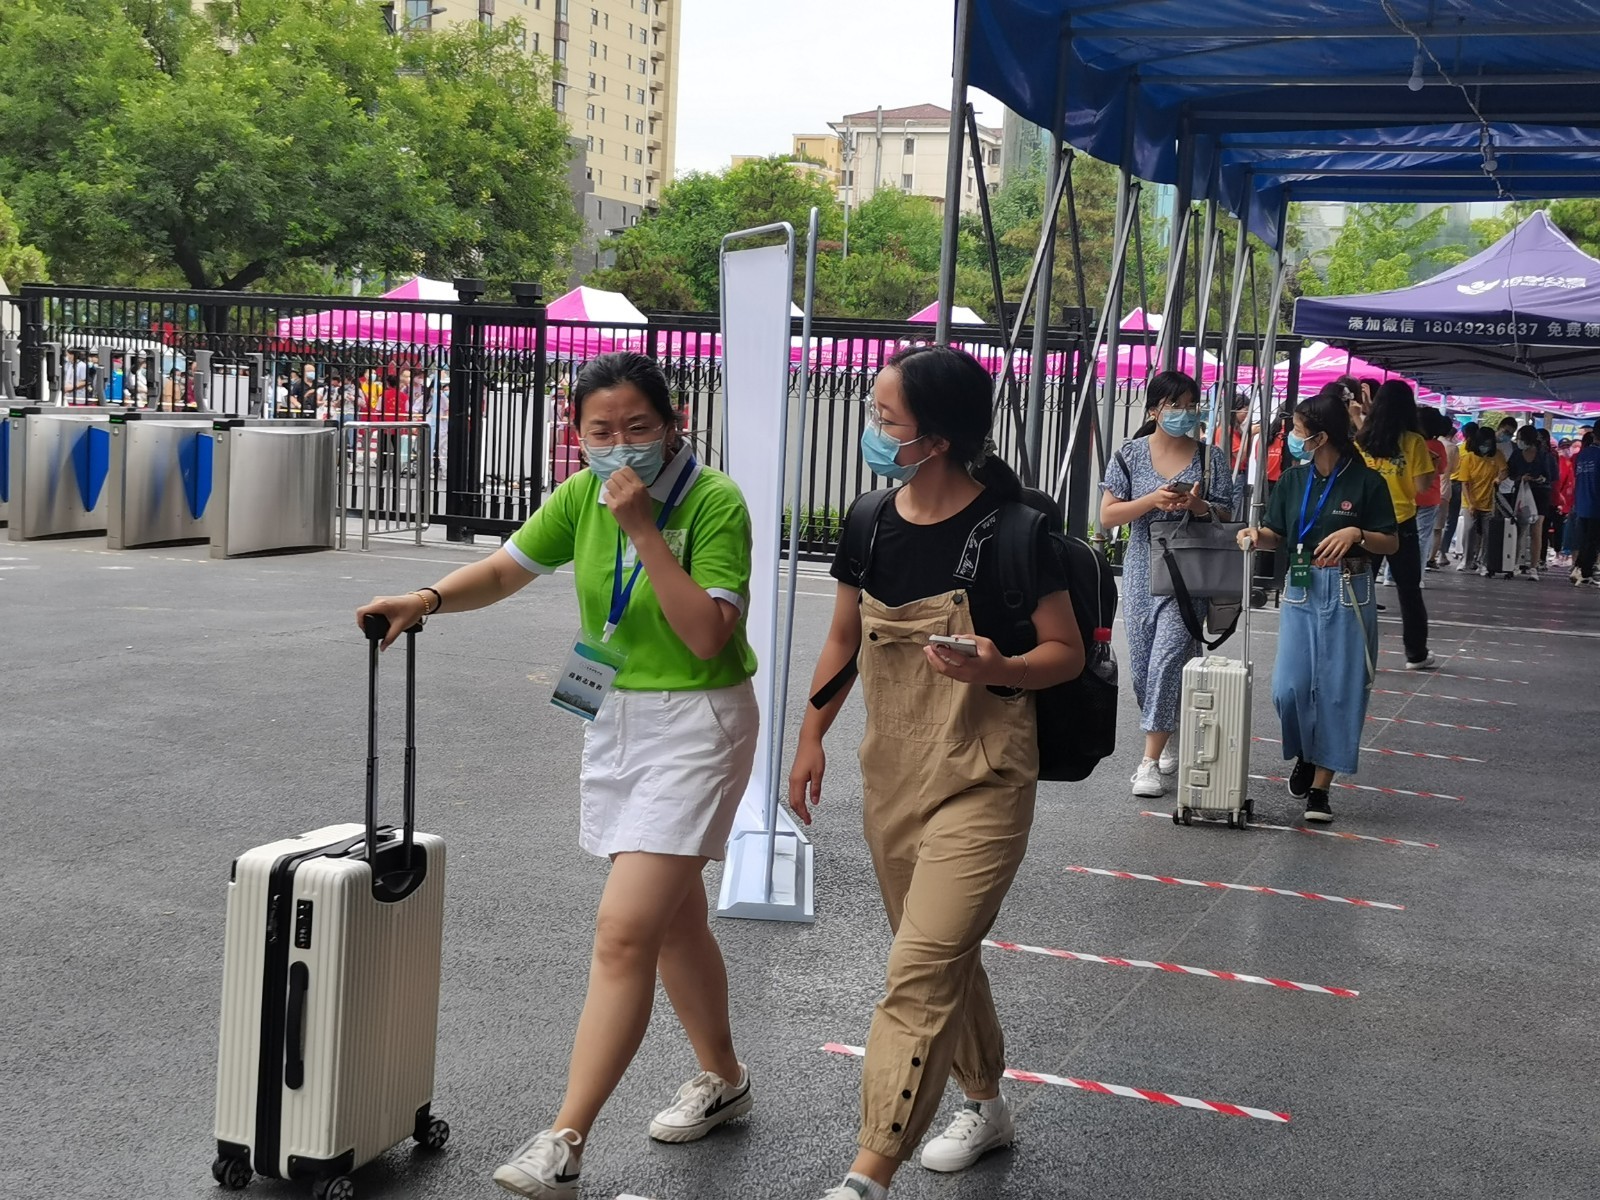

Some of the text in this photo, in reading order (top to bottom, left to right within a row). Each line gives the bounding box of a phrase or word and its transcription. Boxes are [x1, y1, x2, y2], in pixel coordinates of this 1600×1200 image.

[1348, 316, 1600, 338] 添加微信 18049236637 免费领
